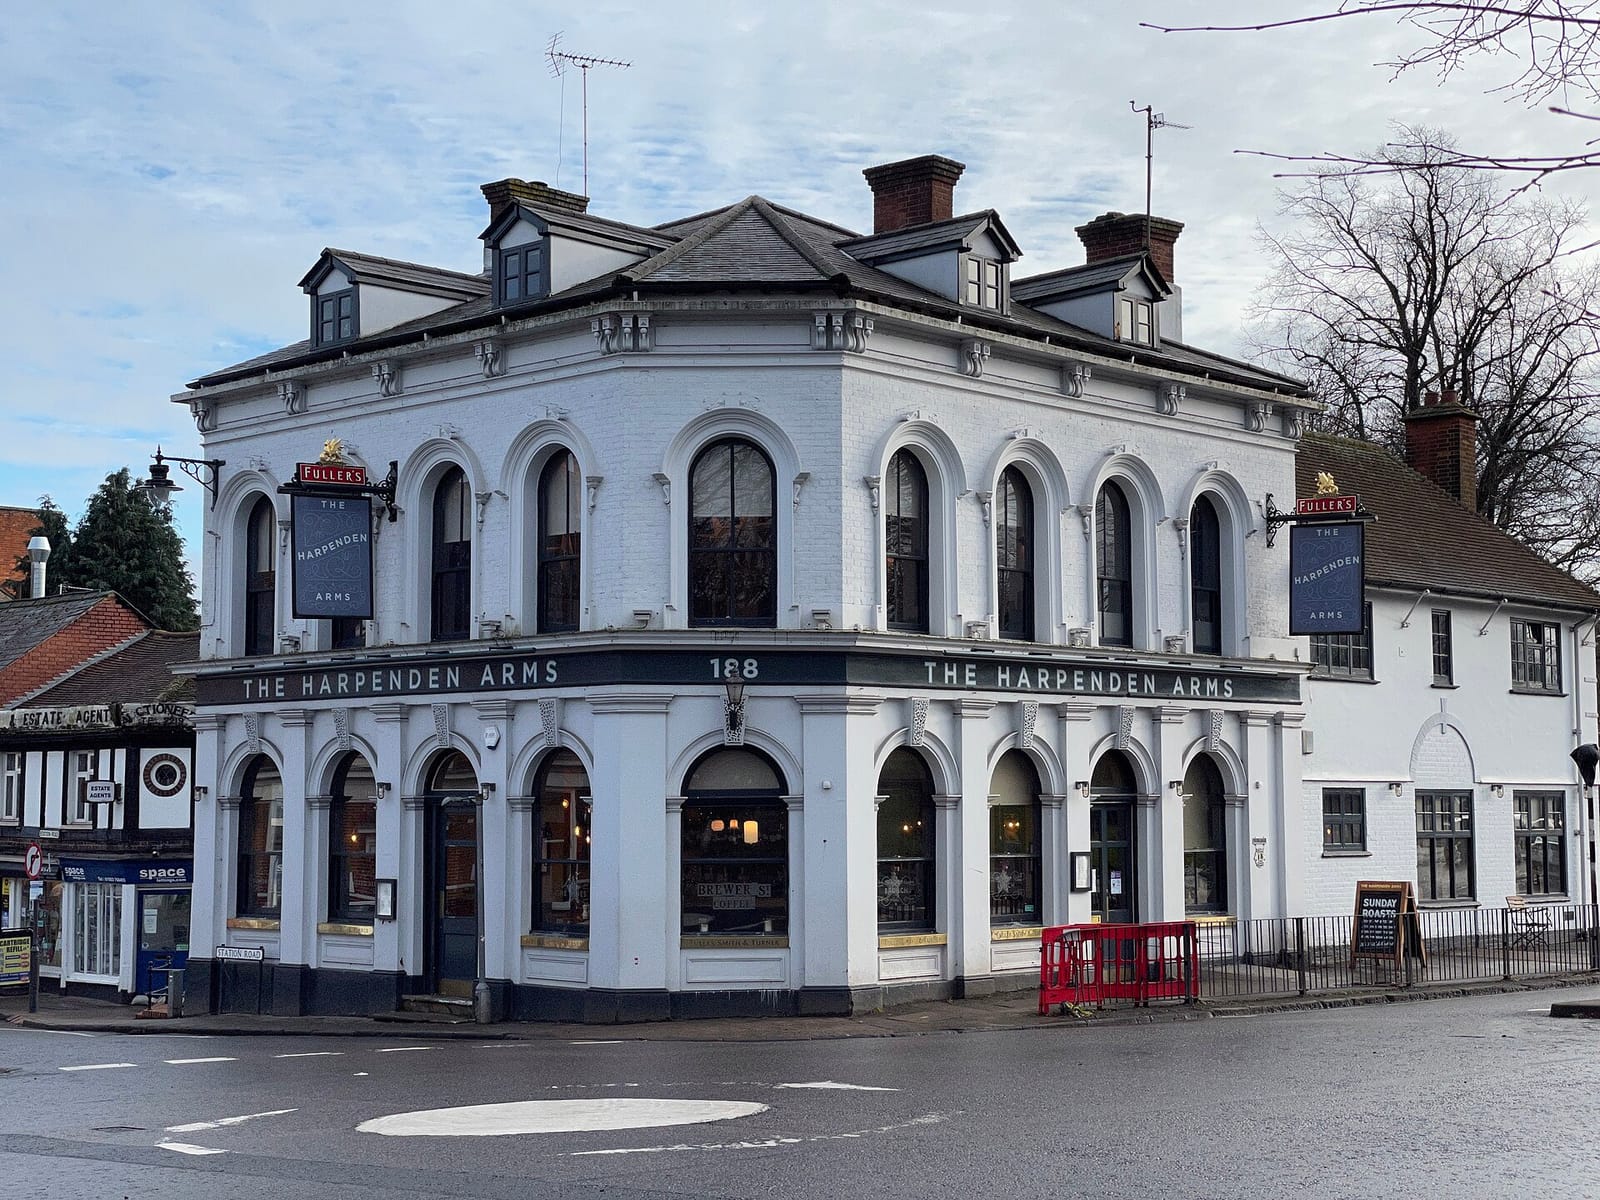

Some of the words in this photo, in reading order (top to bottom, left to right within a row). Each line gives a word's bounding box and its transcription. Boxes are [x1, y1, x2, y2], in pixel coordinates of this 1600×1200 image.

[304, 466, 362, 482] FULLER'S
[321, 500, 345, 509] THE
[1299, 498, 1352, 512] FULLER'S
[1316, 528, 1339, 536] THE
[297, 533, 368, 561] HARPENDEN
[1294, 556, 1360, 584] HARPENDEN
[315, 592, 351, 601] ARMS
[1310, 611, 1343, 619] ARMS
[710, 658, 759, 679] 188
[243, 677, 286, 699] THE
[302, 665, 460, 696] HARPENDEN
[480, 660, 558, 686] ARMS
[924, 661, 977, 685] THE
[997, 665, 1156, 694] HARPENDEN
[1173, 677, 1233, 697] ARMS
[23, 711, 63, 726] ESTATE
[64, 867, 84, 877] space
[139, 868, 186, 880] space
[698, 884, 751, 895] BREWER
[1363, 898, 1397, 907] SUNDAY
[1362, 909, 1397, 918] ROASTS
[217, 949, 243, 958] STATION
[244, 950, 261, 959] ROAD
